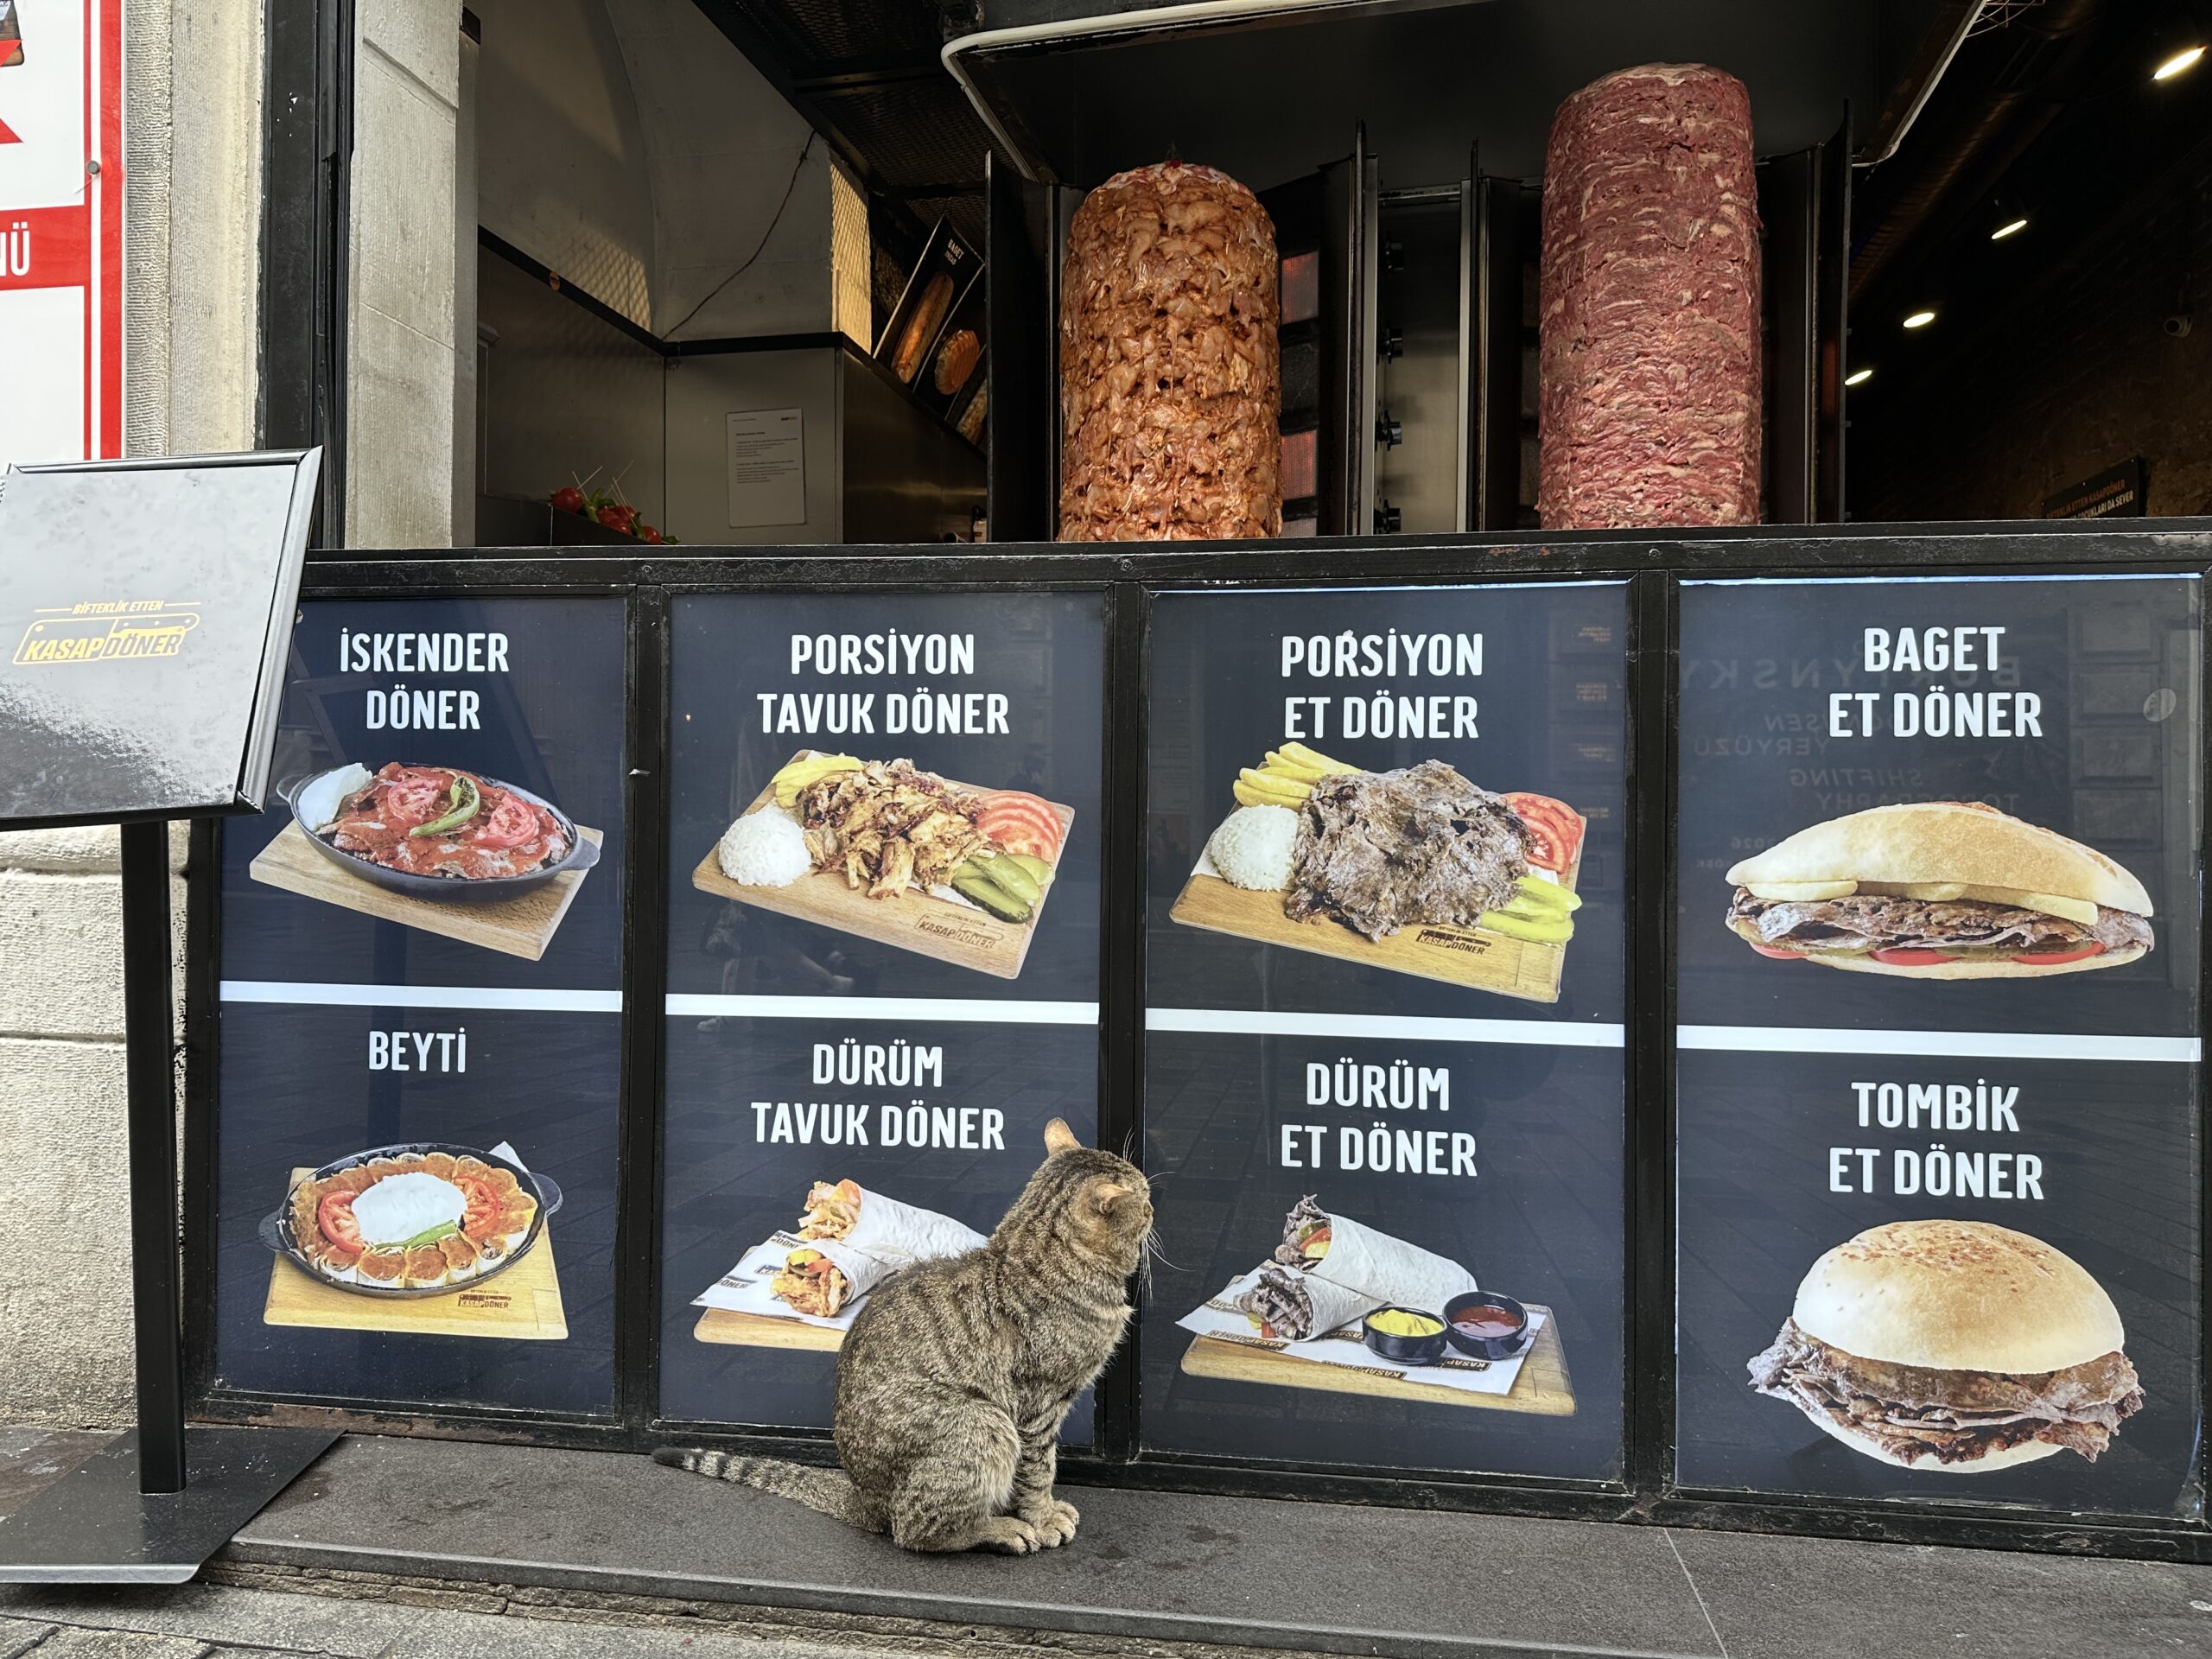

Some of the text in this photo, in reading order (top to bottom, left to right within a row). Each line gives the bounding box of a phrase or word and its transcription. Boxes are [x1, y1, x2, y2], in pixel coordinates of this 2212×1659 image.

[2115, 490, 2134, 507] SEVER
[129, 600, 165, 612] ETTEN
[340, 627, 510, 672] İSKENDER
[791, 627, 976, 675] PORSİYON
[1281, 627, 1484, 677] PORSİYON
[1863, 626, 2006, 672] BAGET
[366, 683, 481, 730] DÖNER
[756, 686, 1010, 734] TAVUK DÖNER
[1284, 690, 1479, 739] ET DÖNER
[1828, 685, 2044, 738] ET DÖNER
[368, 1027, 467, 1073] BEYTİ
[812, 1037, 944, 1088] DÜRÜM
[1306, 1057, 1451, 1111] DÜRÜM
[1850, 1077, 2021, 1132] TOMBİK
[750, 1099, 1006, 1150] TAVUK DÖNER
[1281, 1121, 1478, 1177] ET DÖNER
[1828, 1143, 2045, 1200] ET DÖNER
[1330, 1330, 1363, 1339] ASAP
